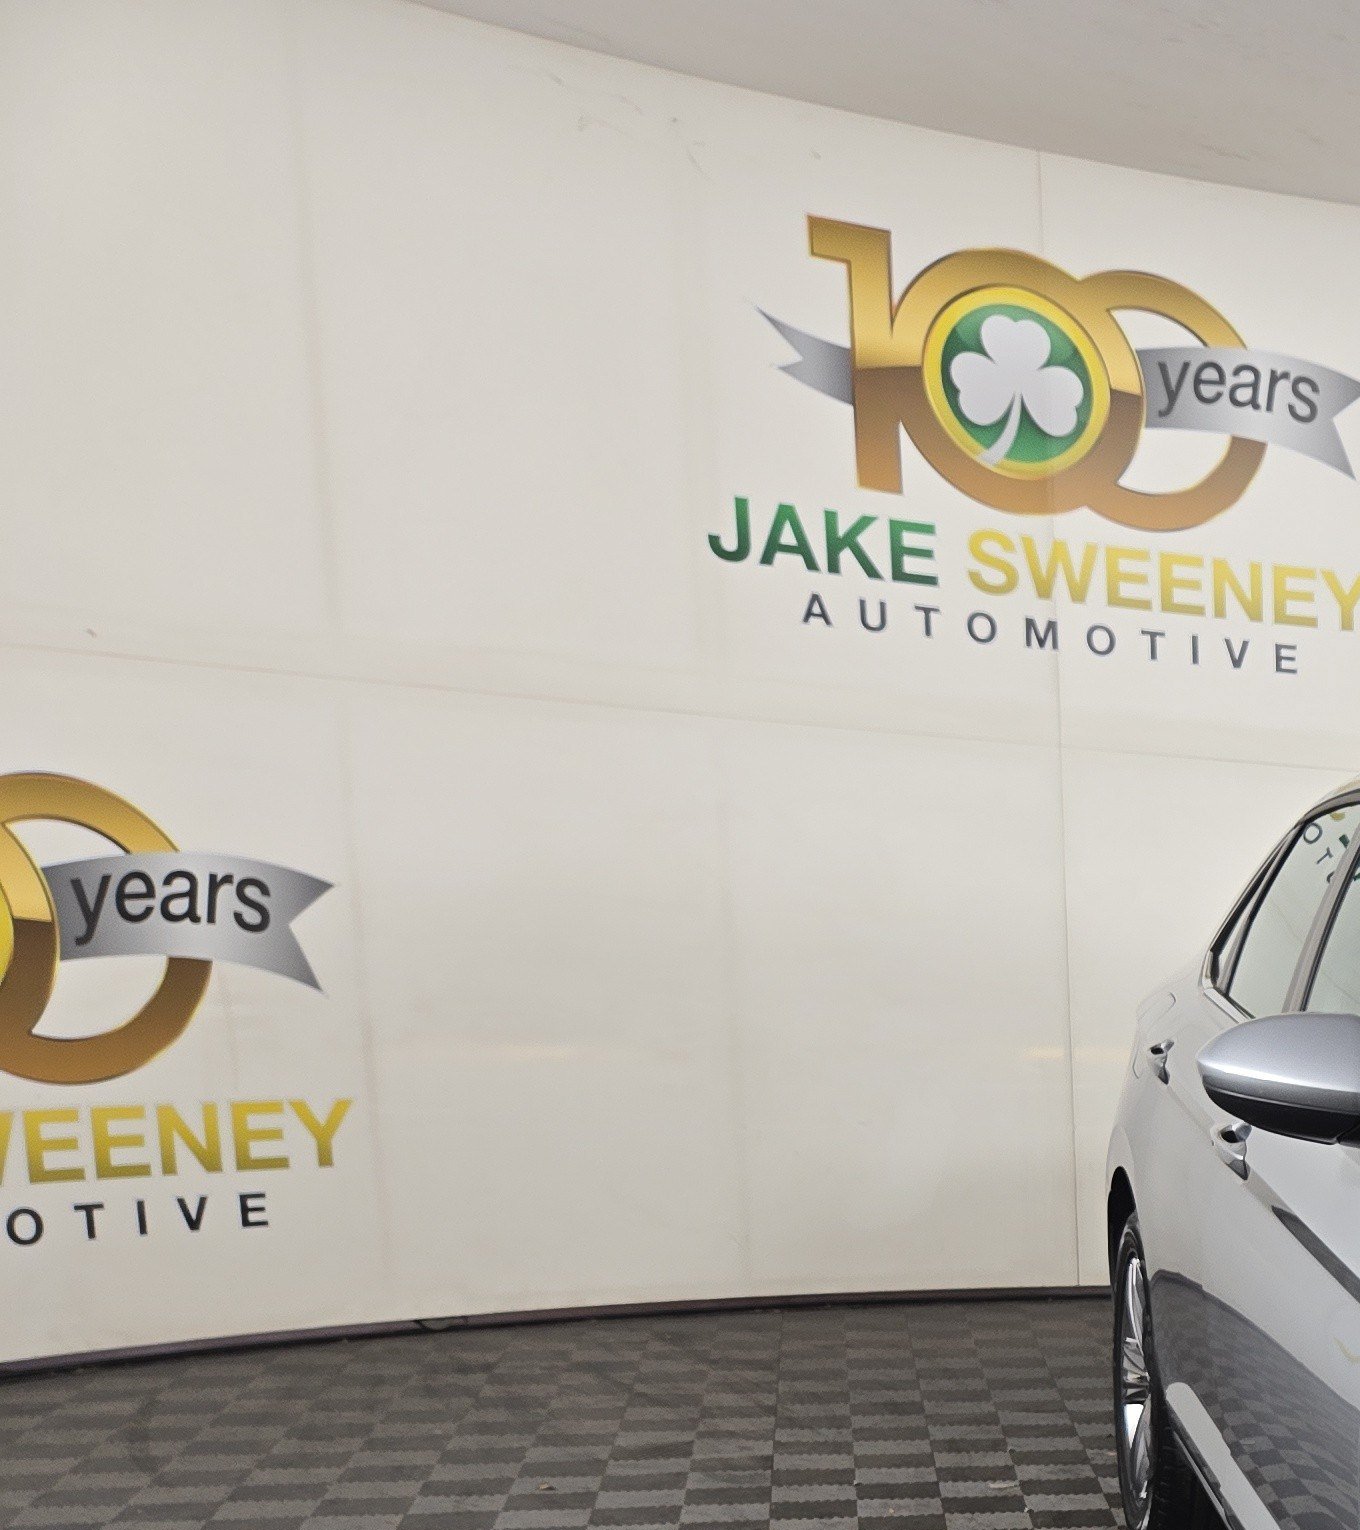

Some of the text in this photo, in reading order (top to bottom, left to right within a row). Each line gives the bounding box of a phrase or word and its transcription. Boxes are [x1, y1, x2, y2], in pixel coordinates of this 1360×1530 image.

[806, 212, 1268, 533] 100
[1157, 359, 1321, 424] years
[708, 496, 940, 587] JAKE
[802, 593, 1299, 675] AUTOMOTIVE
[69, 867, 271, 946] years
